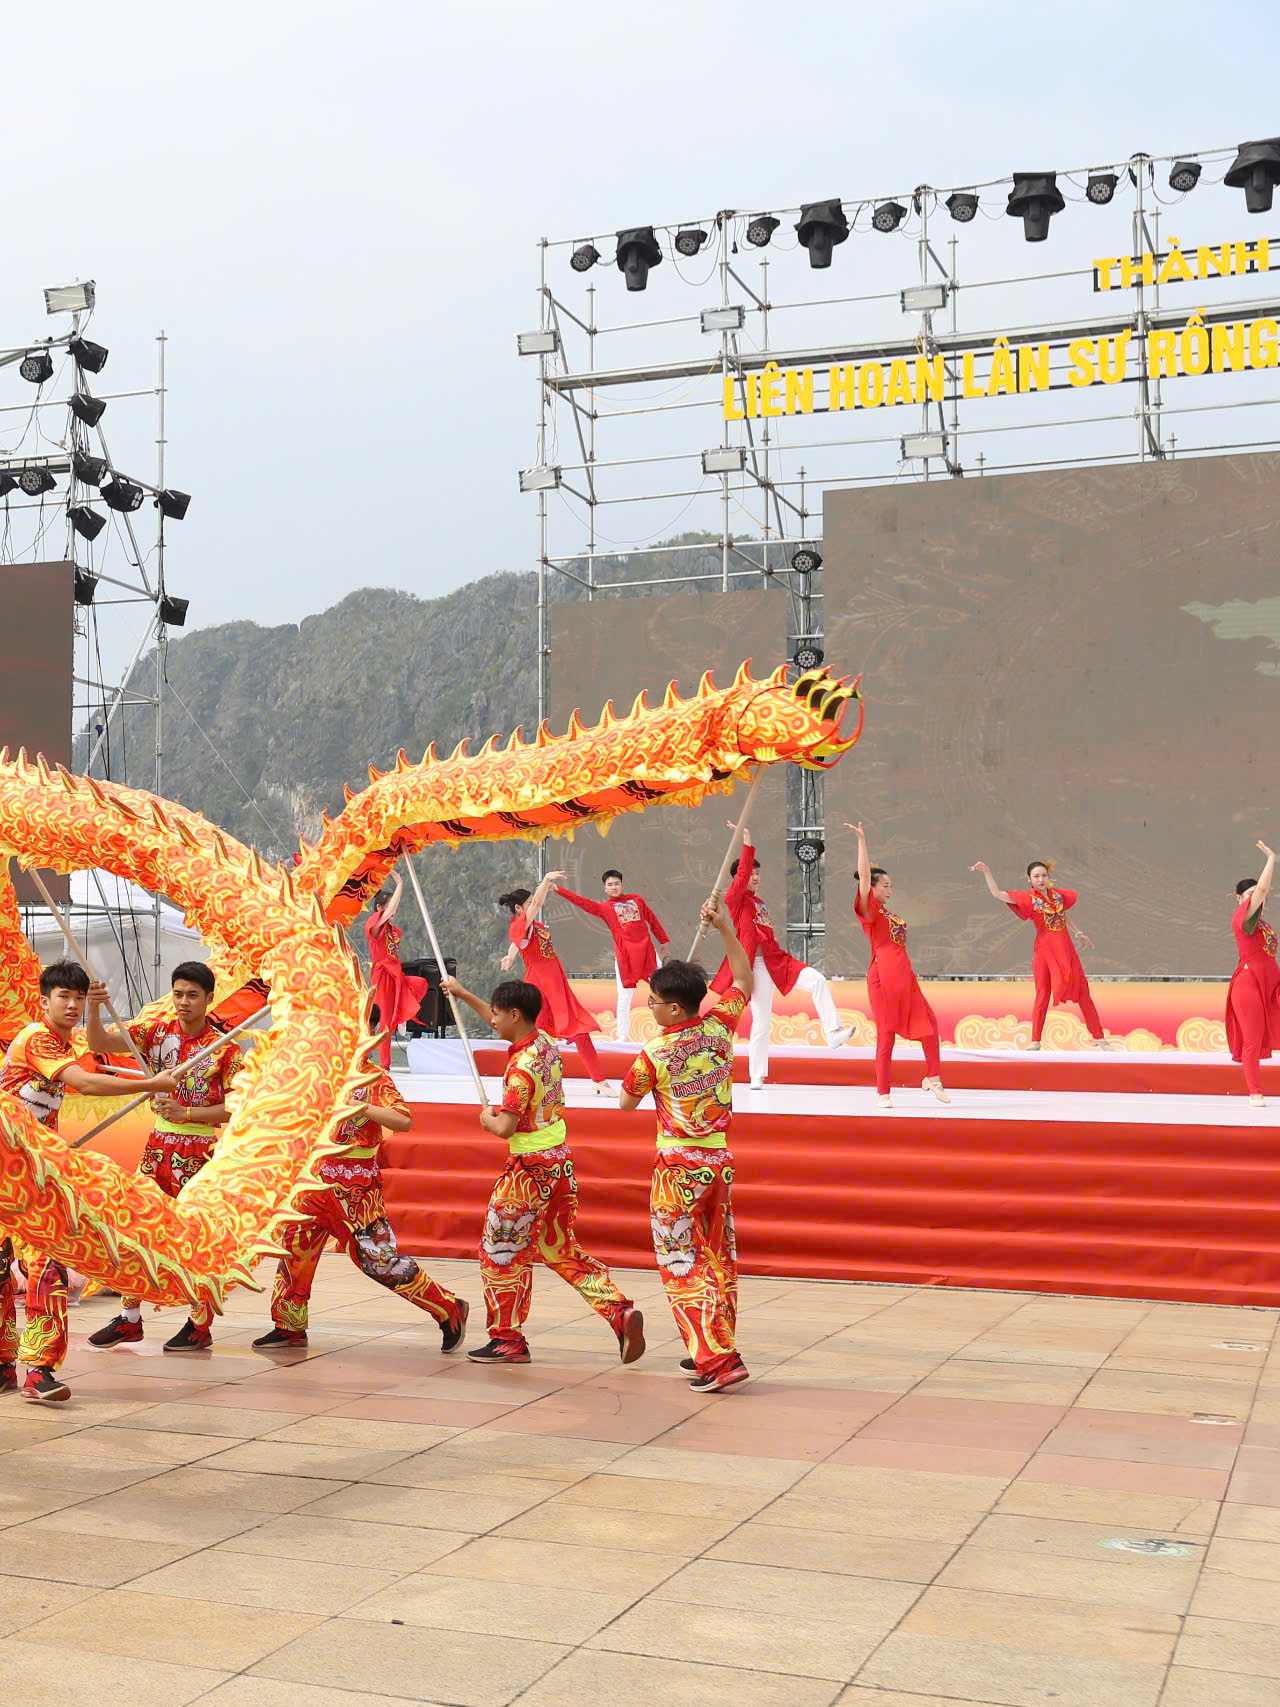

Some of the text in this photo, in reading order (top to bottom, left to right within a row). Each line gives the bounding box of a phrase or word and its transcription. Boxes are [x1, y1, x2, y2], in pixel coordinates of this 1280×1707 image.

[1093, 236, 1269, 291] THÀNH
[724, 306, 1279, 421] LIÊN HOAN LÂN SƯ RỒNG
